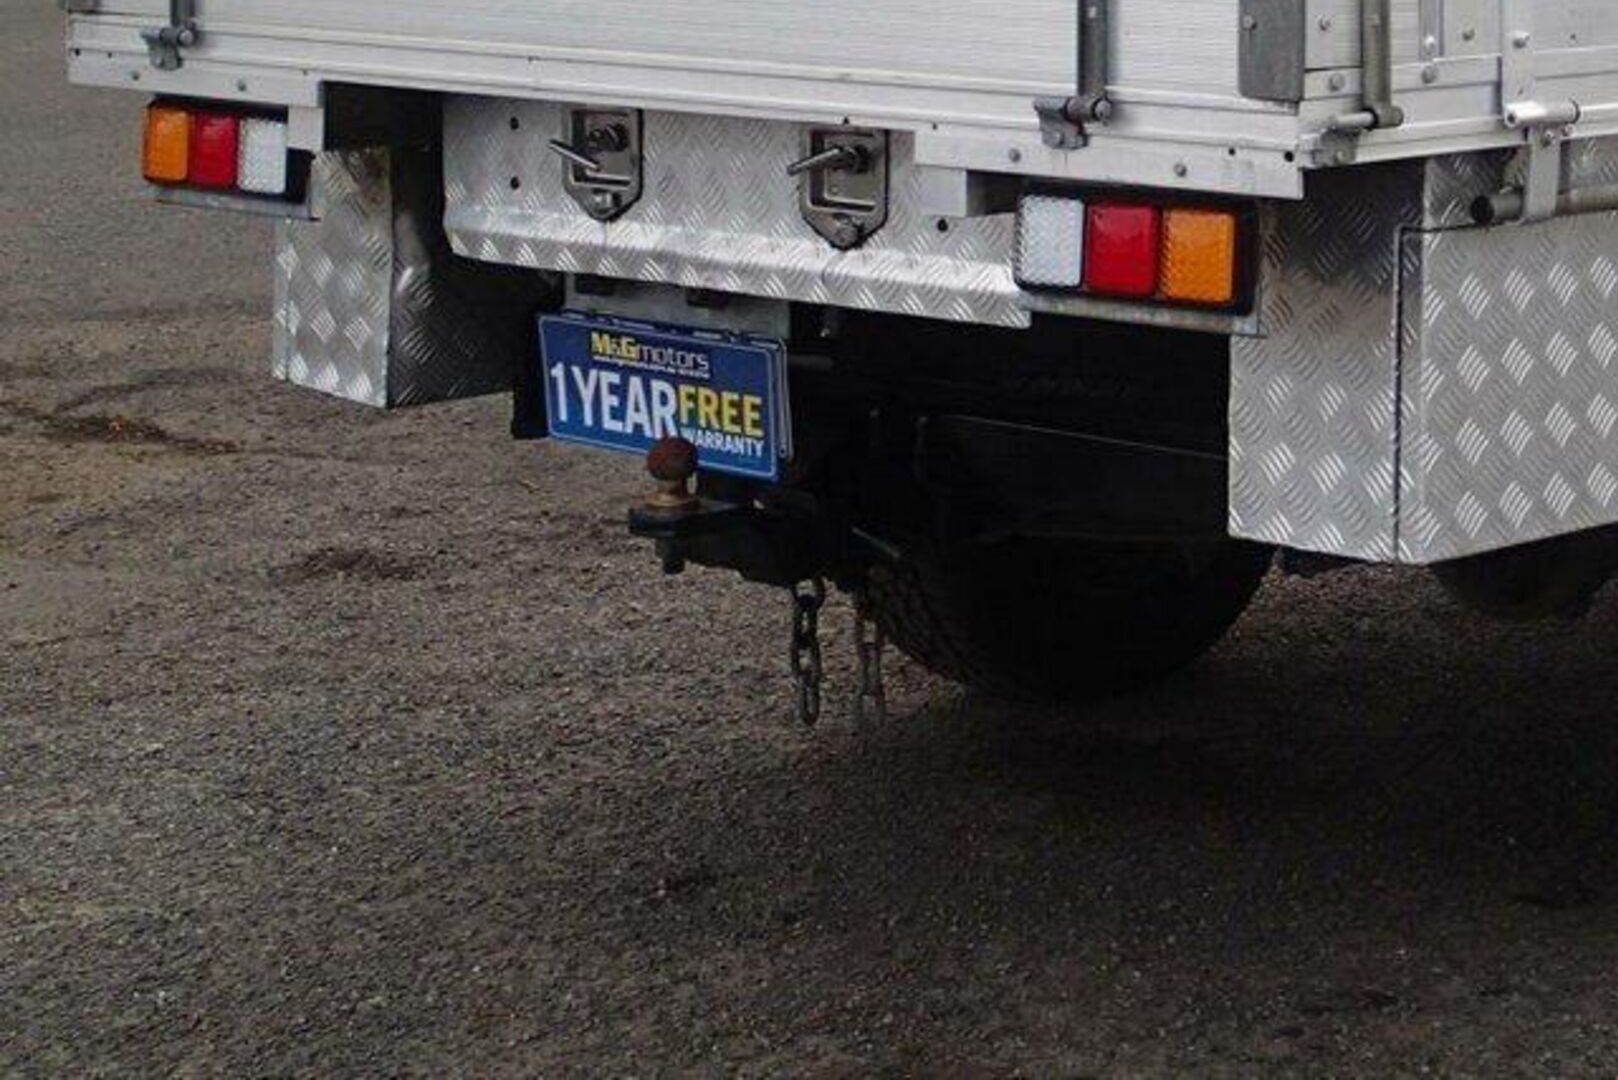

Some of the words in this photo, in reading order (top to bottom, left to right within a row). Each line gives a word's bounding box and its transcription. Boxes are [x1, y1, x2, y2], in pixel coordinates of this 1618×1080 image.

[550, 361, 569, 422] 1
[571, 366, 678, 440] YEAR
[678, 384, 765, 438] FREE
[680, 426, 765, 458] WARRANTY
